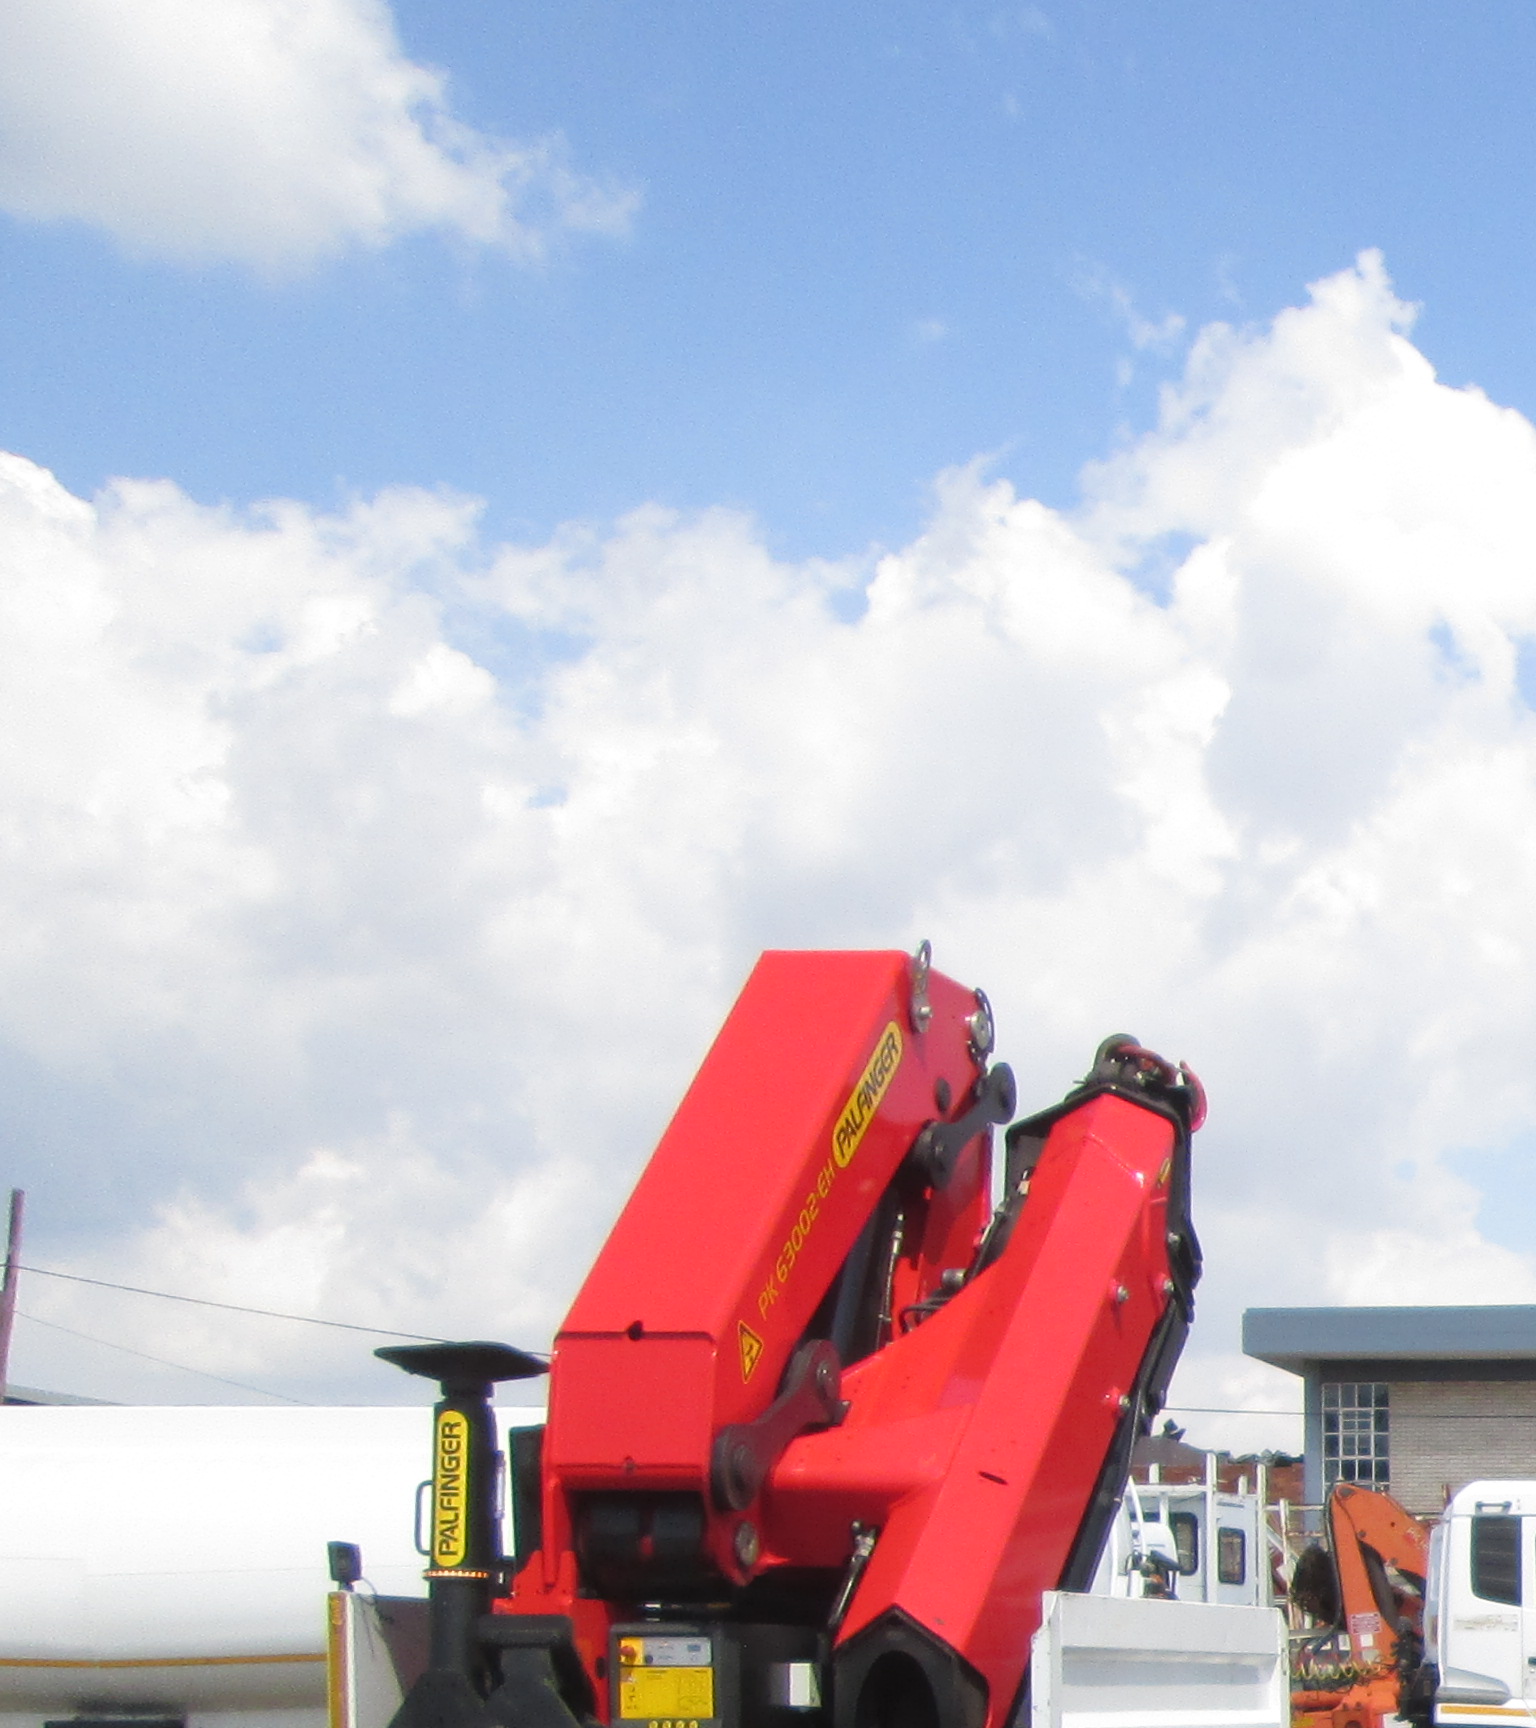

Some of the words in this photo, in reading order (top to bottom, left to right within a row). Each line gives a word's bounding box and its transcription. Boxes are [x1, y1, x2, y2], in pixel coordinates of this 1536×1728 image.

[835, 1032, 898, 1160] PALFINGER
[758, 1274, 779, 1322] PK
[438, 1421, 462, 1556] PALFINGER
